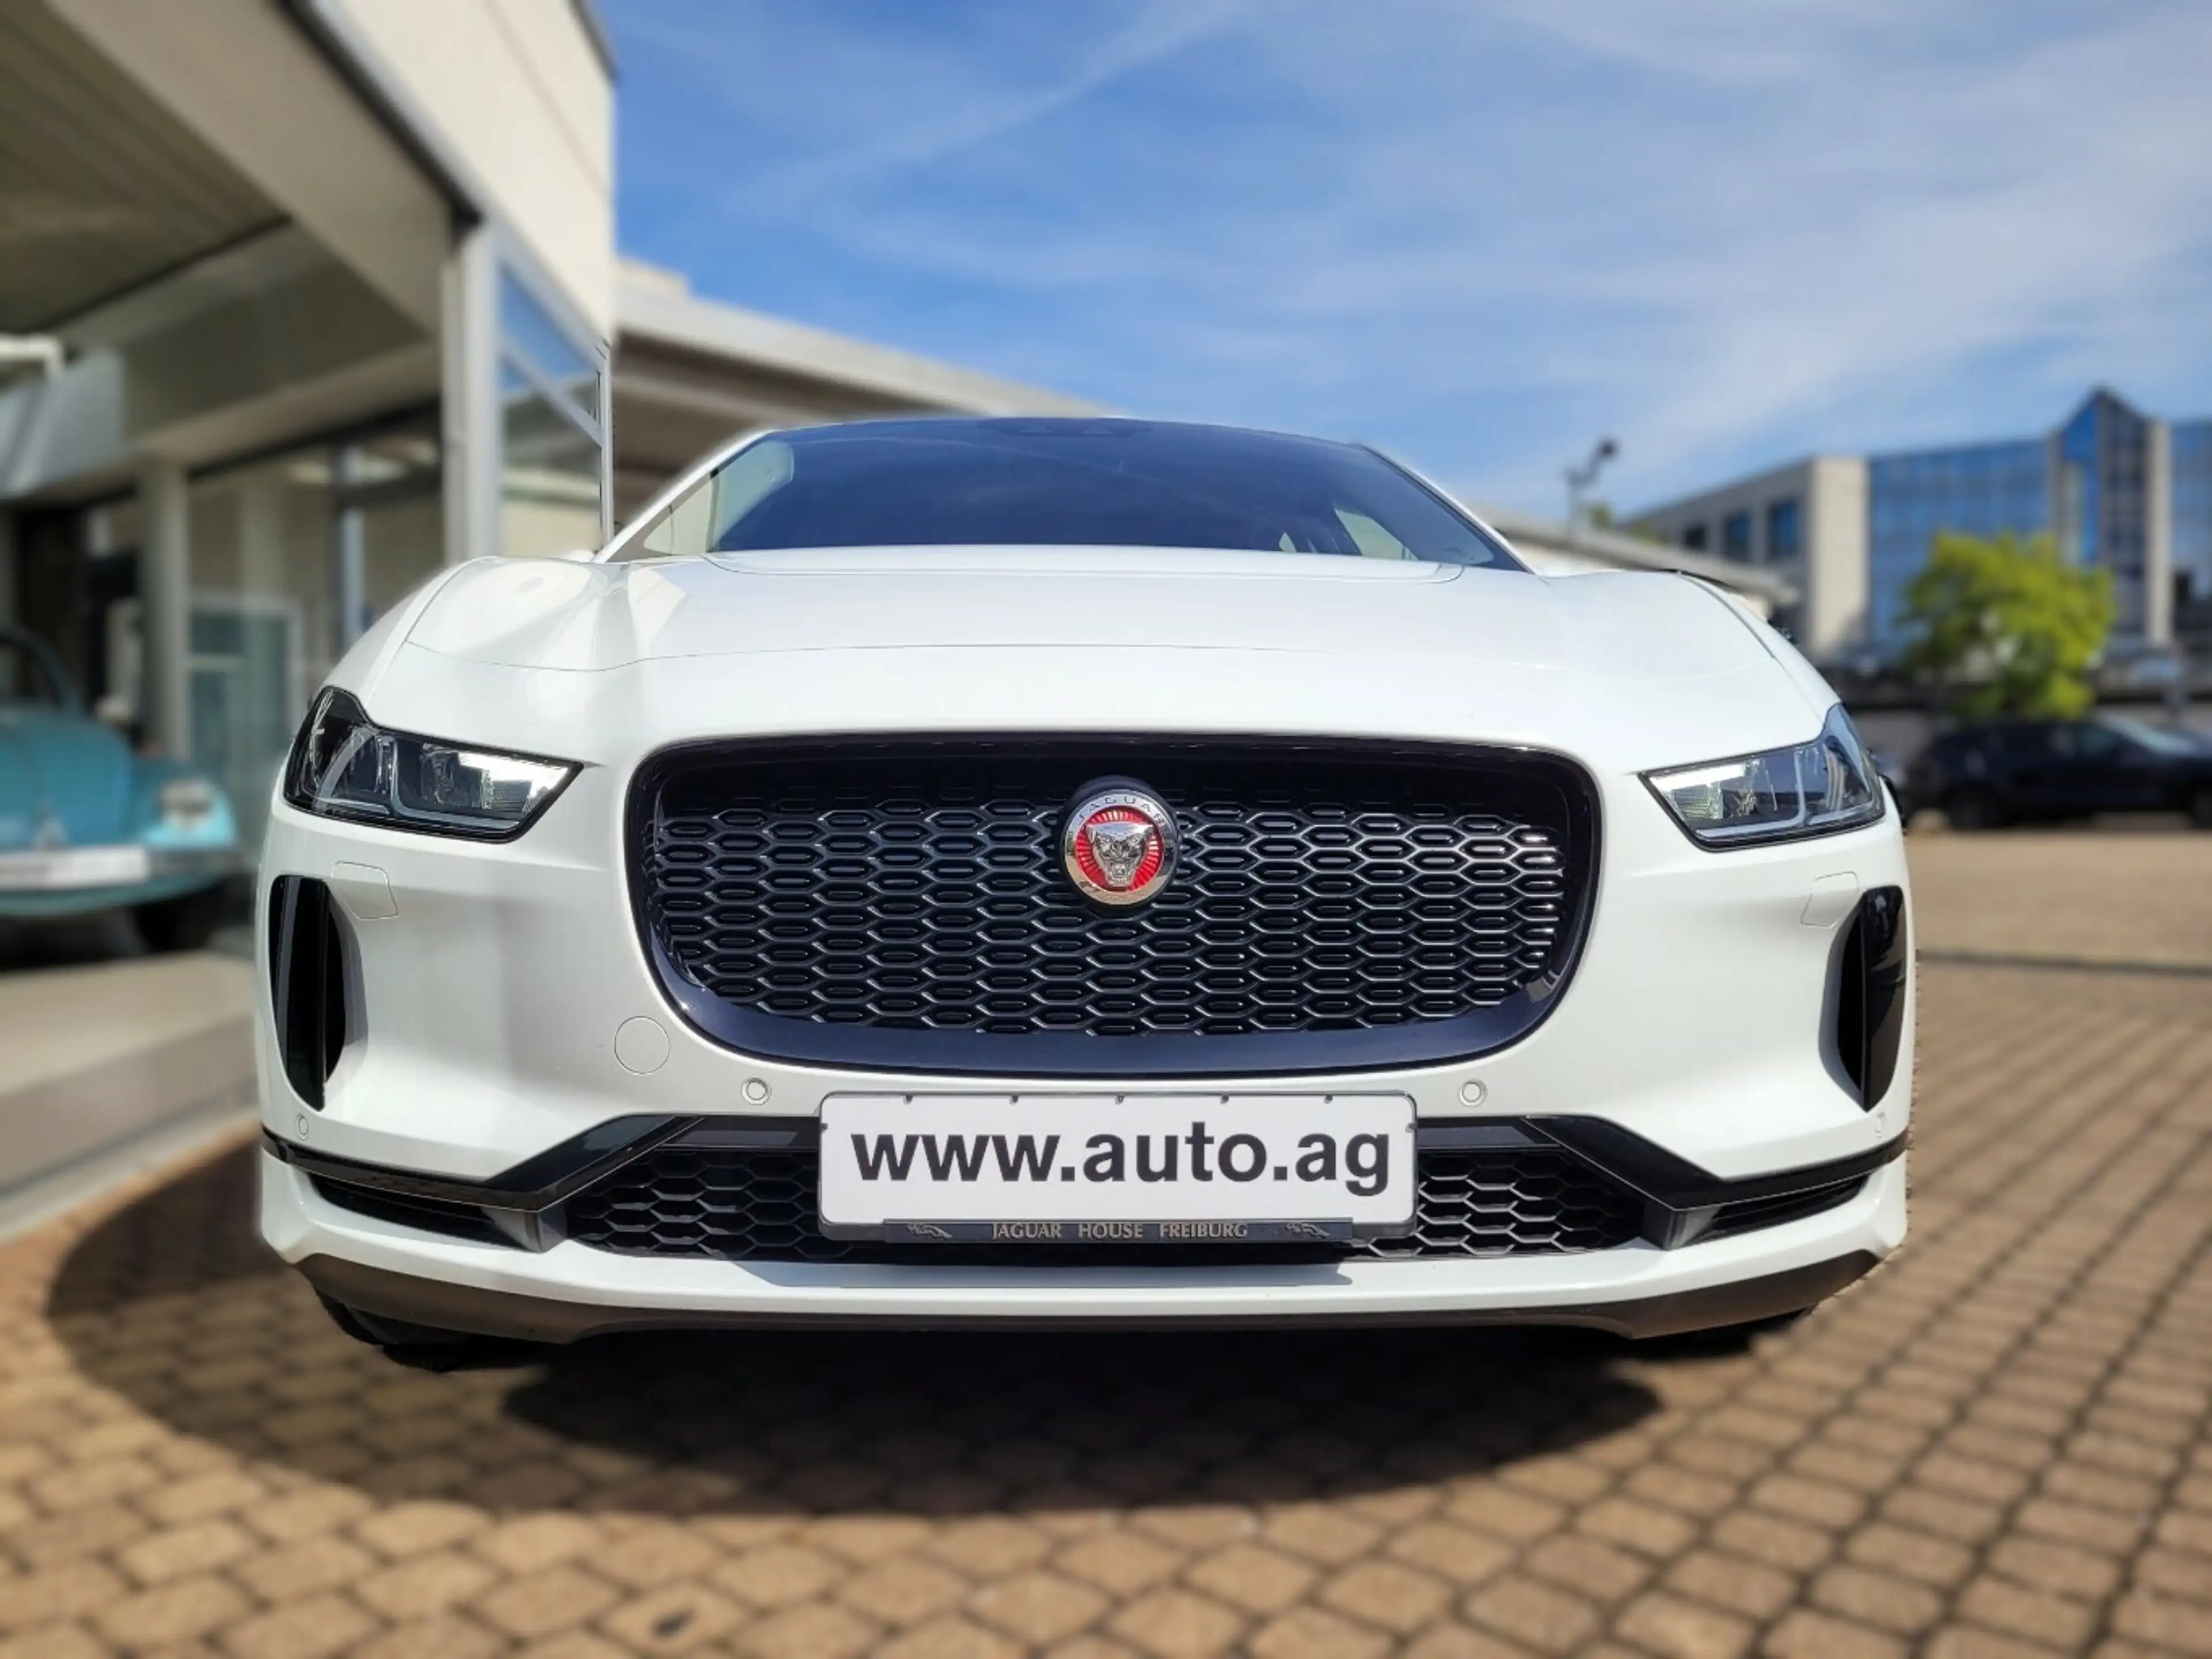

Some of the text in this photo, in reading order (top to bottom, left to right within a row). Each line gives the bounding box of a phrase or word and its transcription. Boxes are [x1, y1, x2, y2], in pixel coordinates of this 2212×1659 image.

[851, 1122, 1389, 1196] www.auto.ag
[991, 1222, 1248, 1240] JAGUAR HOUSE FREIBURG
